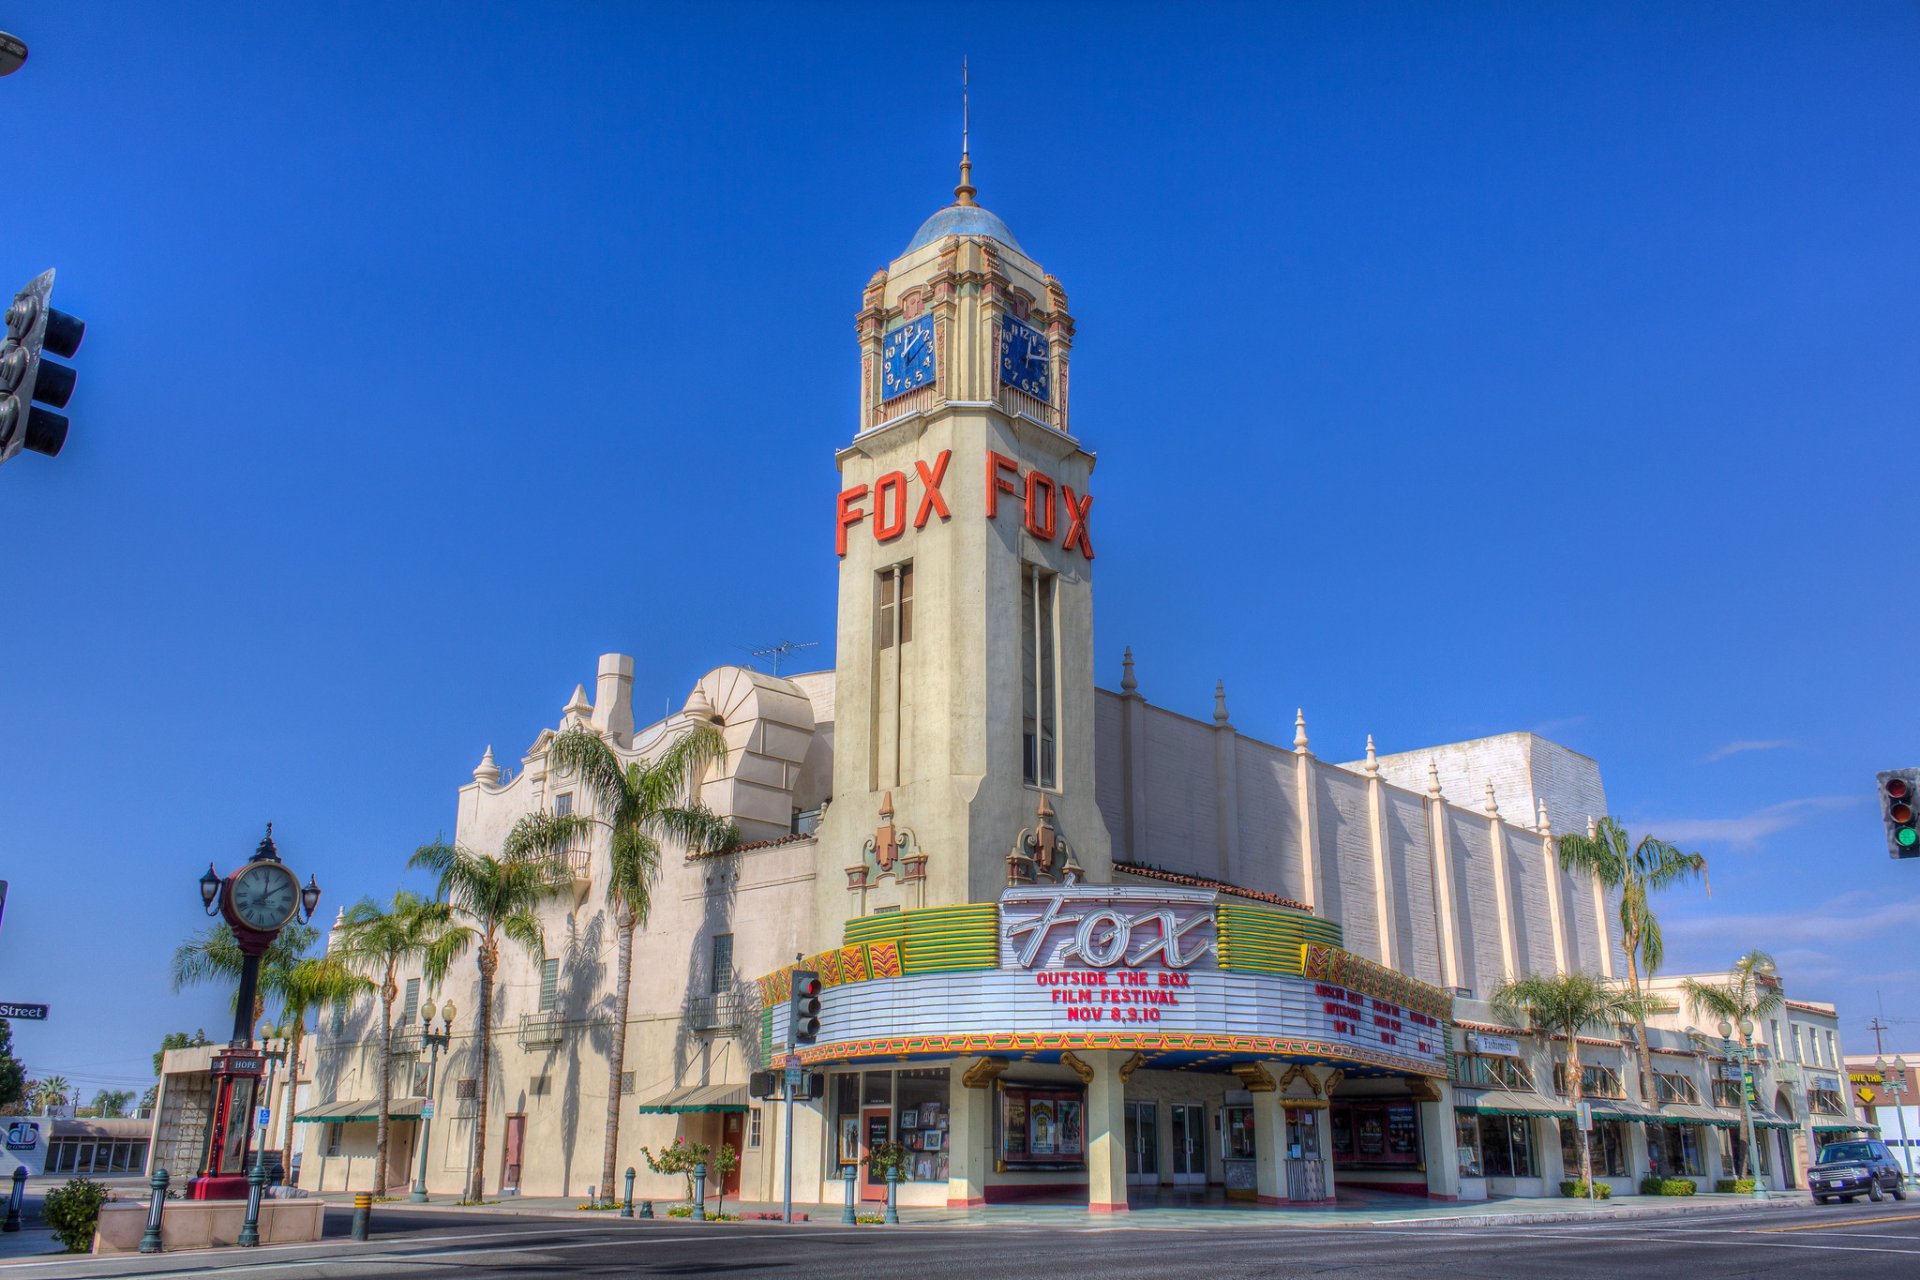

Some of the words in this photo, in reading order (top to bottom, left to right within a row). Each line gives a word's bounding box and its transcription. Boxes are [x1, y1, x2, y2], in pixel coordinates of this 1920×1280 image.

[923, 330, 929, 340] 2
[1002, 329, 1012, 342] 10
[1011, 324, 1018, 336] 11
[1020, 326, 1029, 339] 12
[895, 333, 901, 344] 11
[886, 347, 895, 358] 10
[928, 341, 933, 353] 3
[1002, 342, 1009, 354] 9
[885, 362, 891, 372] 9
[923, 356, 931, 367] 4
[1004, 358, 1011, 369] 8
[887, 374, 893, 385] 8
[916, 371, 922, 381] 5
[1012, 371, 1018, 380] 7
[894, 379, 900, 392] 7
[905, 378, 911, 389] 6
[1022, 379, 1029, 390] 6
[1032, 381, 1039, 393] 5
[836, 449, 952, 557] FOX
[986, 450, 1095, 560] FOX
[1036, 971, 1108, 987] OUTSIDE
[1117, 971, 1149, 987] THE
[1158, 972, 1190, 988] BOX
[1051, 989, 1092, 1004] FILM
[1100, 989, 1179, 1006] FESTIVAL
[0, 1005, 43, 1017] Street
[1067, 1007, 1103, 1022] NOV
[234, 1061, 257, 1069] HOPE
[1849, 1073, 1866, 1082] RIVE
[1867, 1074, 1882, 1083] THR
